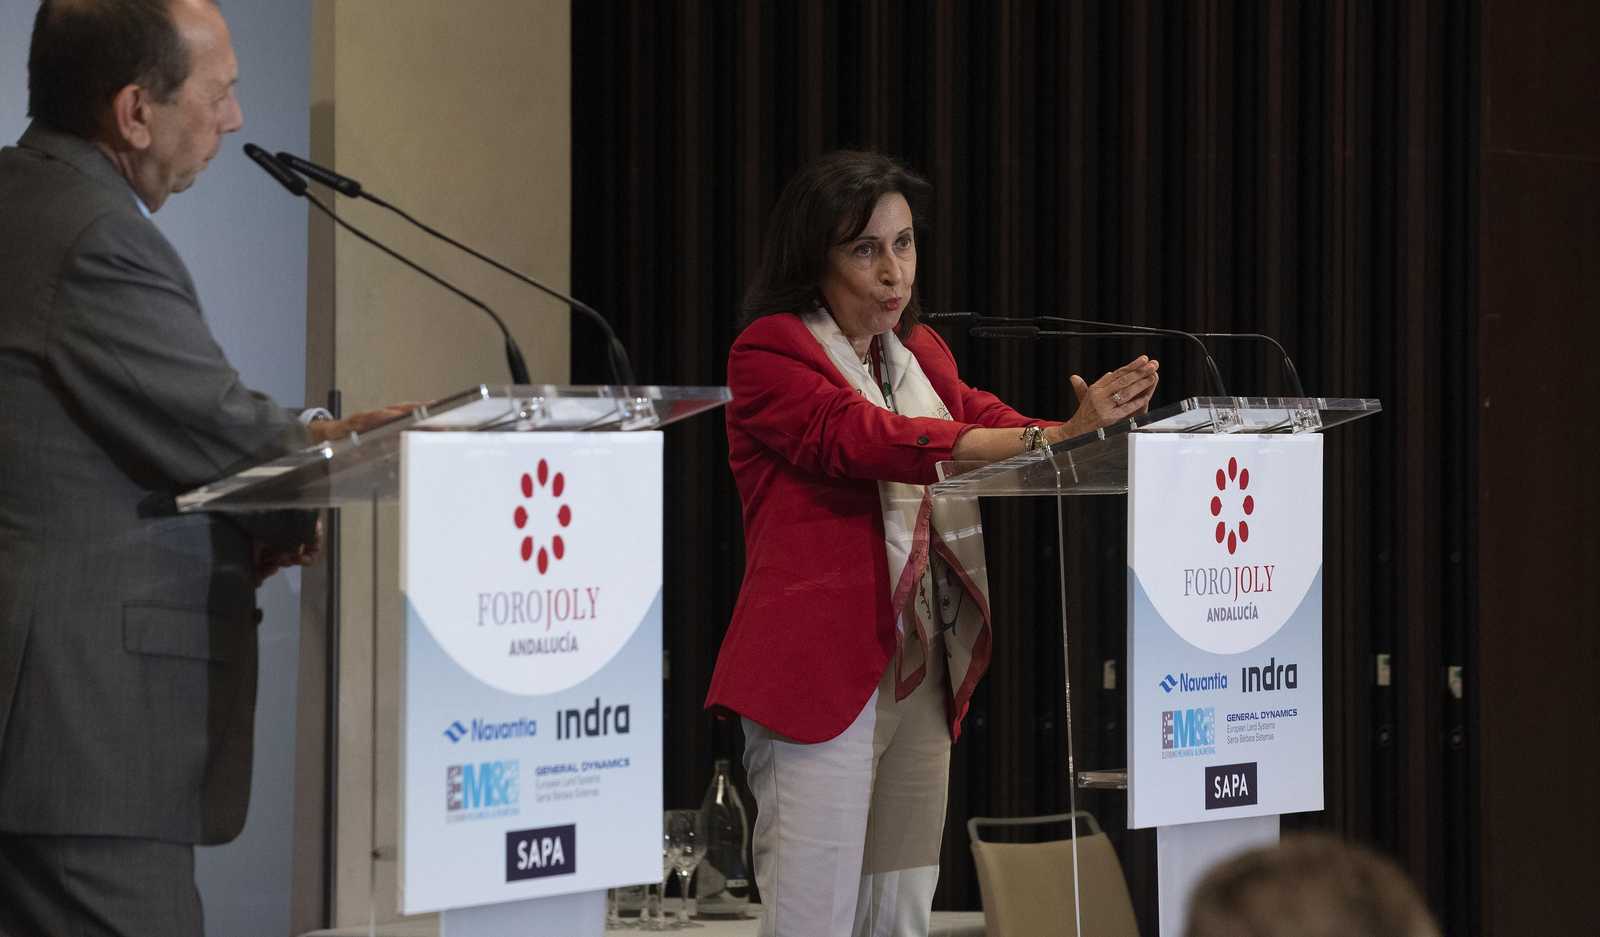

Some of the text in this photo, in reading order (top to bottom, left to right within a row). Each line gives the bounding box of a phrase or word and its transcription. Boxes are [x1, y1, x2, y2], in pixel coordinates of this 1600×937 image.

[1206, 602, 1259, 623] ANDALUCÍA
[508, 631, 579, 657] ANDALUCÍA
[1180, 672, 1228, 693] Navantia
[1242, 657, 1298, 693] indra
[556, 697, 630, 741] indra
[1226, 708, 1298, 722] GENERAL DYNAMICS
[471, 717, 538, 742] Navantia
[1226, 722, 1276, 734] European Land Systems
[535, 757, 630, 777] GENERAL DYNAMICS
[1214, 773, 1249, 799] SAPA
[516, 836, 565, 871] SAPA
